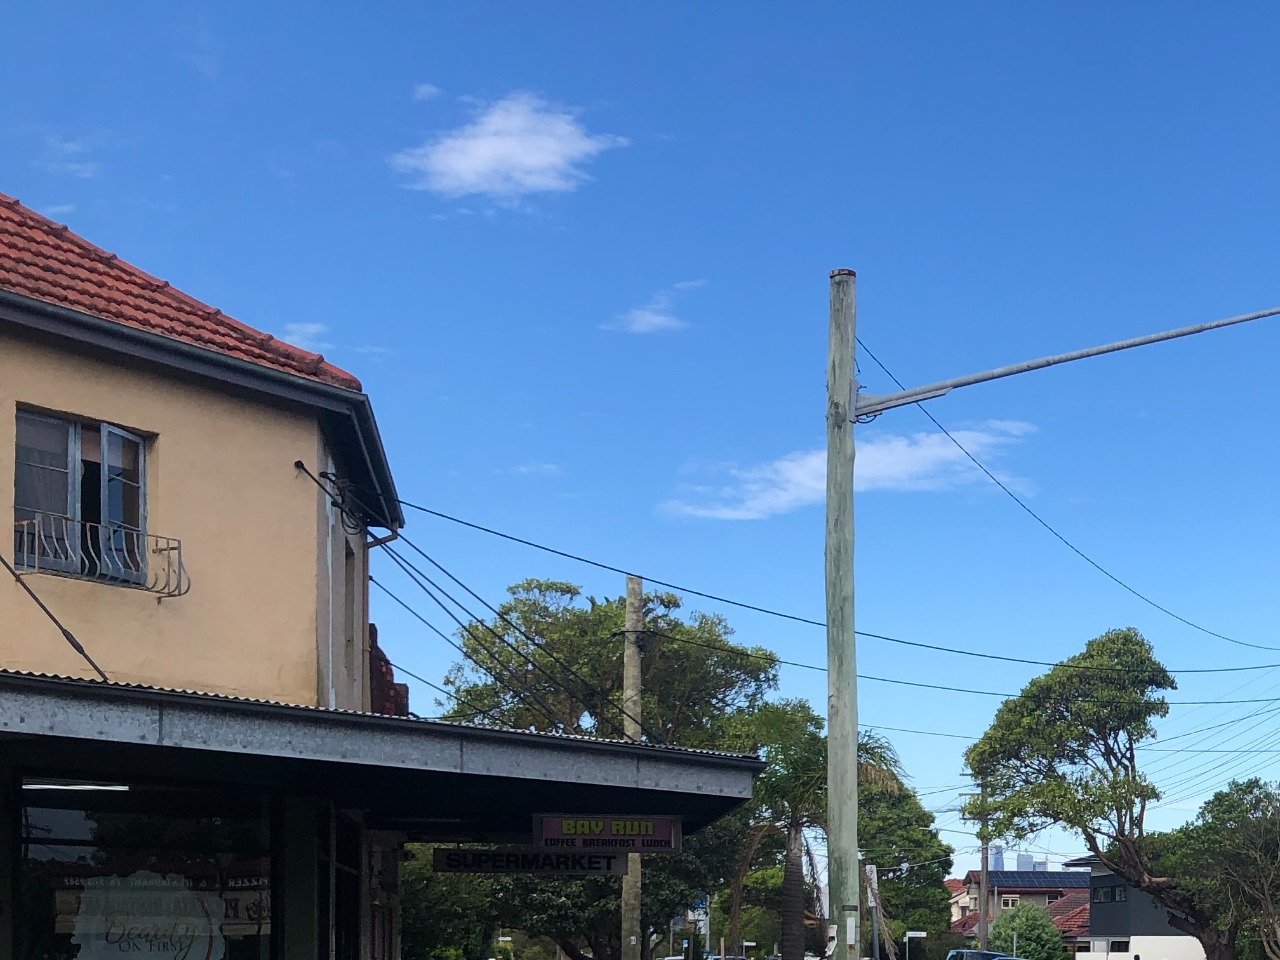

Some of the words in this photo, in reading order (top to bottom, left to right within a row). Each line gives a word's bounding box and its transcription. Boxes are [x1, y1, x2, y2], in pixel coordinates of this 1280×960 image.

[562, 820, 604, 836] BAY
[611, 820, 655, 836] RUN
[544, 838, 577, 848] COFFEE
[583, 838, 636, 848] BREAKFAST
[642, 838, 671, 848] LUNCH
[446, 852, 616, 871] SUPERMARKET
[119, 940, 141, 952] ON
[148, 941, 185, 952] FIRST
